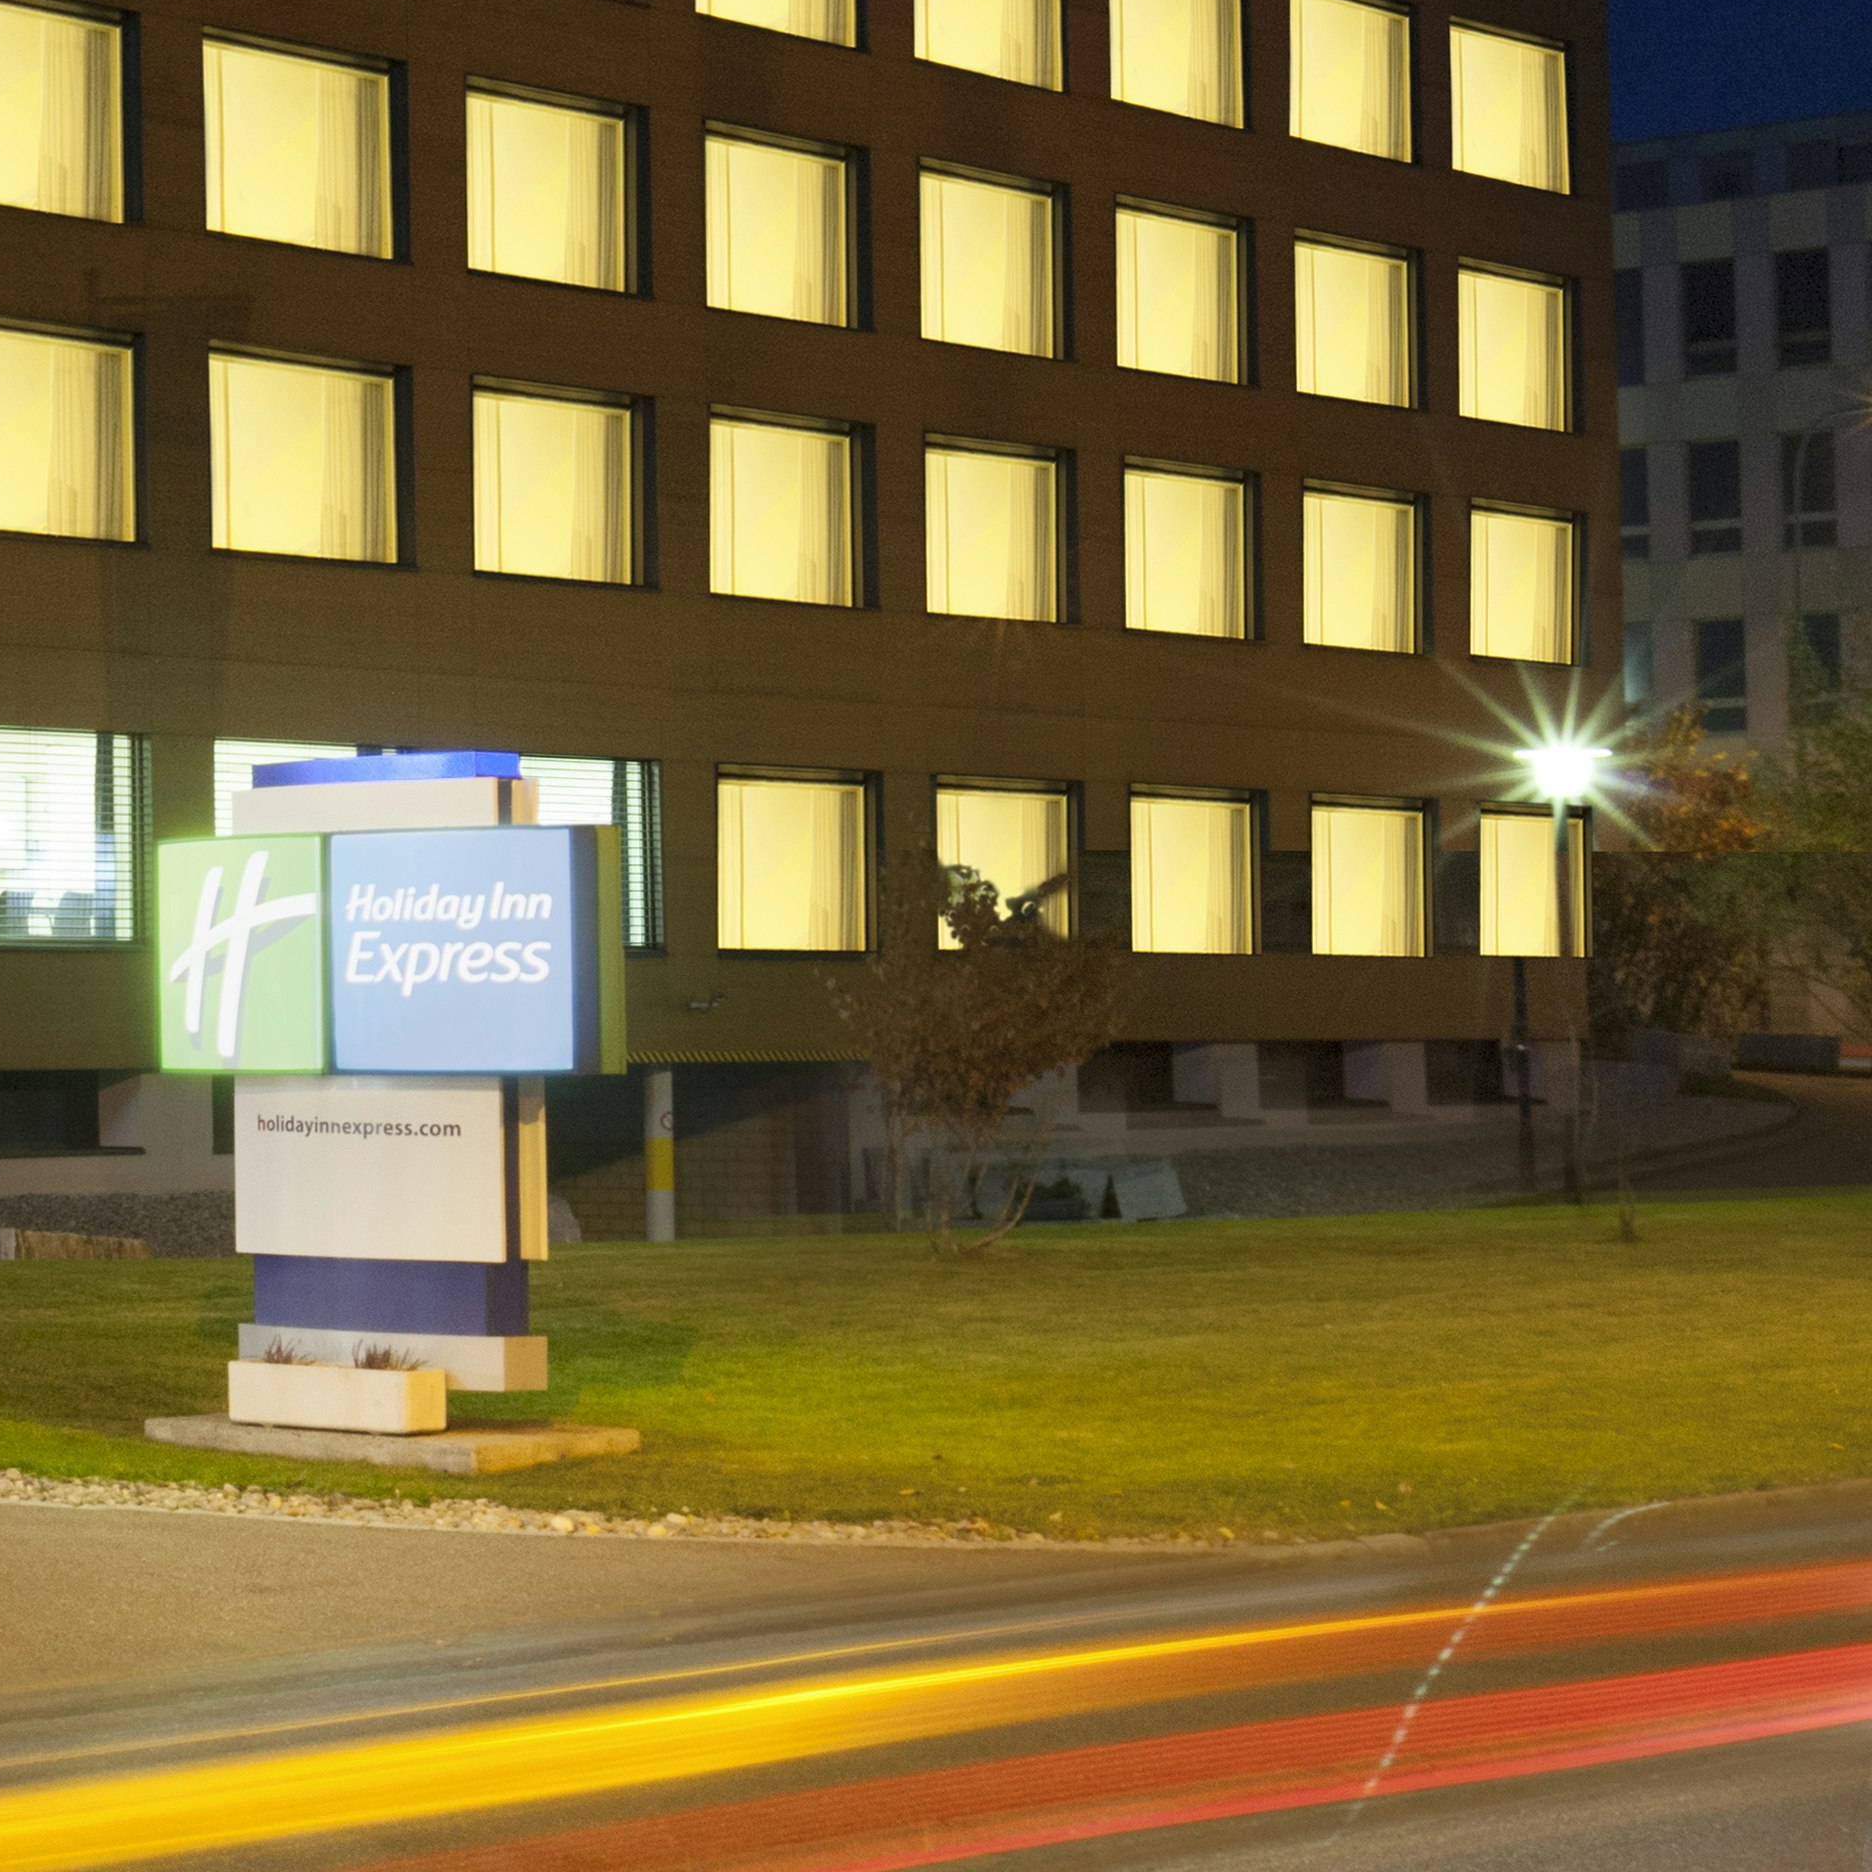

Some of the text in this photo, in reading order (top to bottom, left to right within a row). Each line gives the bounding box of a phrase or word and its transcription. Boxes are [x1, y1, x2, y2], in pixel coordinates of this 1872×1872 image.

[345, 881, 553, 930] Holiday Inn
[345, 930, 552, 998] Express
[257, 1114, 462, 1139] holidayinnexpress.com
